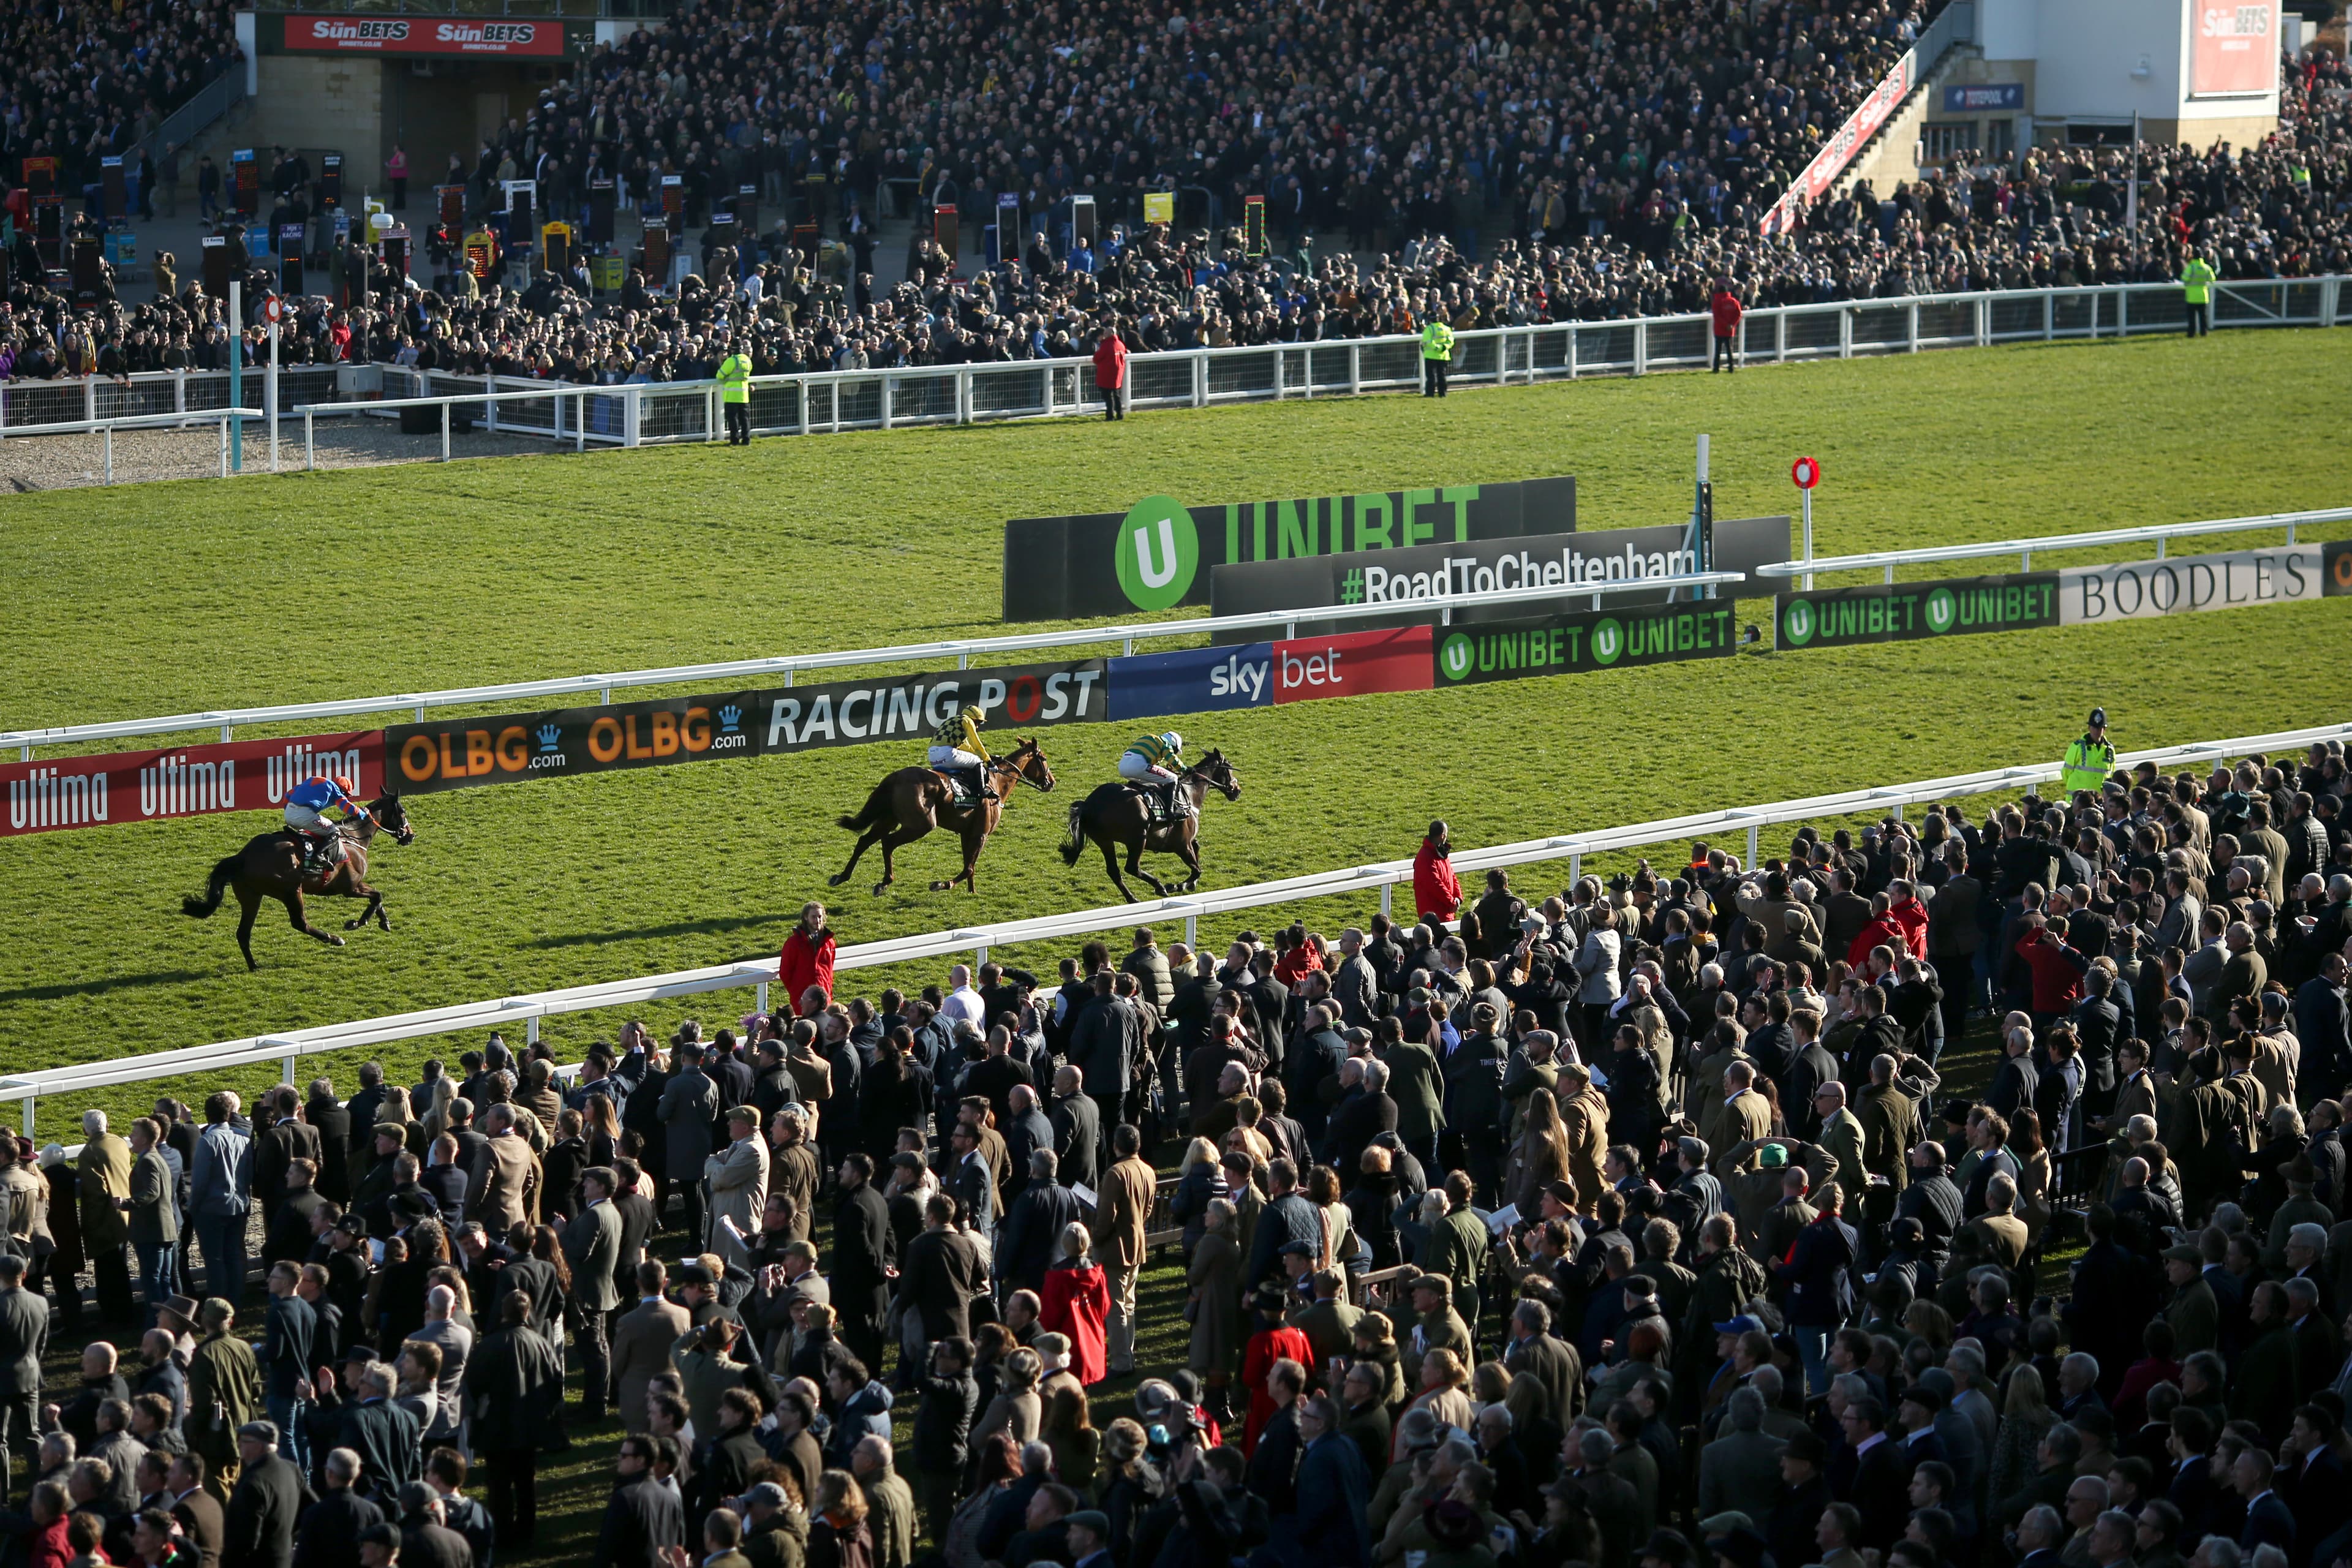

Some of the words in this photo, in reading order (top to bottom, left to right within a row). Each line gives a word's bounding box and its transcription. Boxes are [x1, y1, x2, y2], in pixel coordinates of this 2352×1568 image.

[1341, 543, 1695, 603] #RoadToCheltenham
[2080, 553, 2306, 619] BOODLES
[1820, 595, 1918, 638] UNIBET
[1959, 583, 2055, 625] UNIBET
[1479, 627, 1583, 672] UNIBET
[1628, 611, 1729, 656] UNIBET
[1210, 654, 1268, 701] sky
[1283, 647, 1342, 688] bet
[767, 681, 960, 747] RACING
[978, 669, 1101, 722] POST
[10, 767, 108, 829] ultima
[140, 755, 235, 816] ultima
[267, 744, 360, 804] ultima
